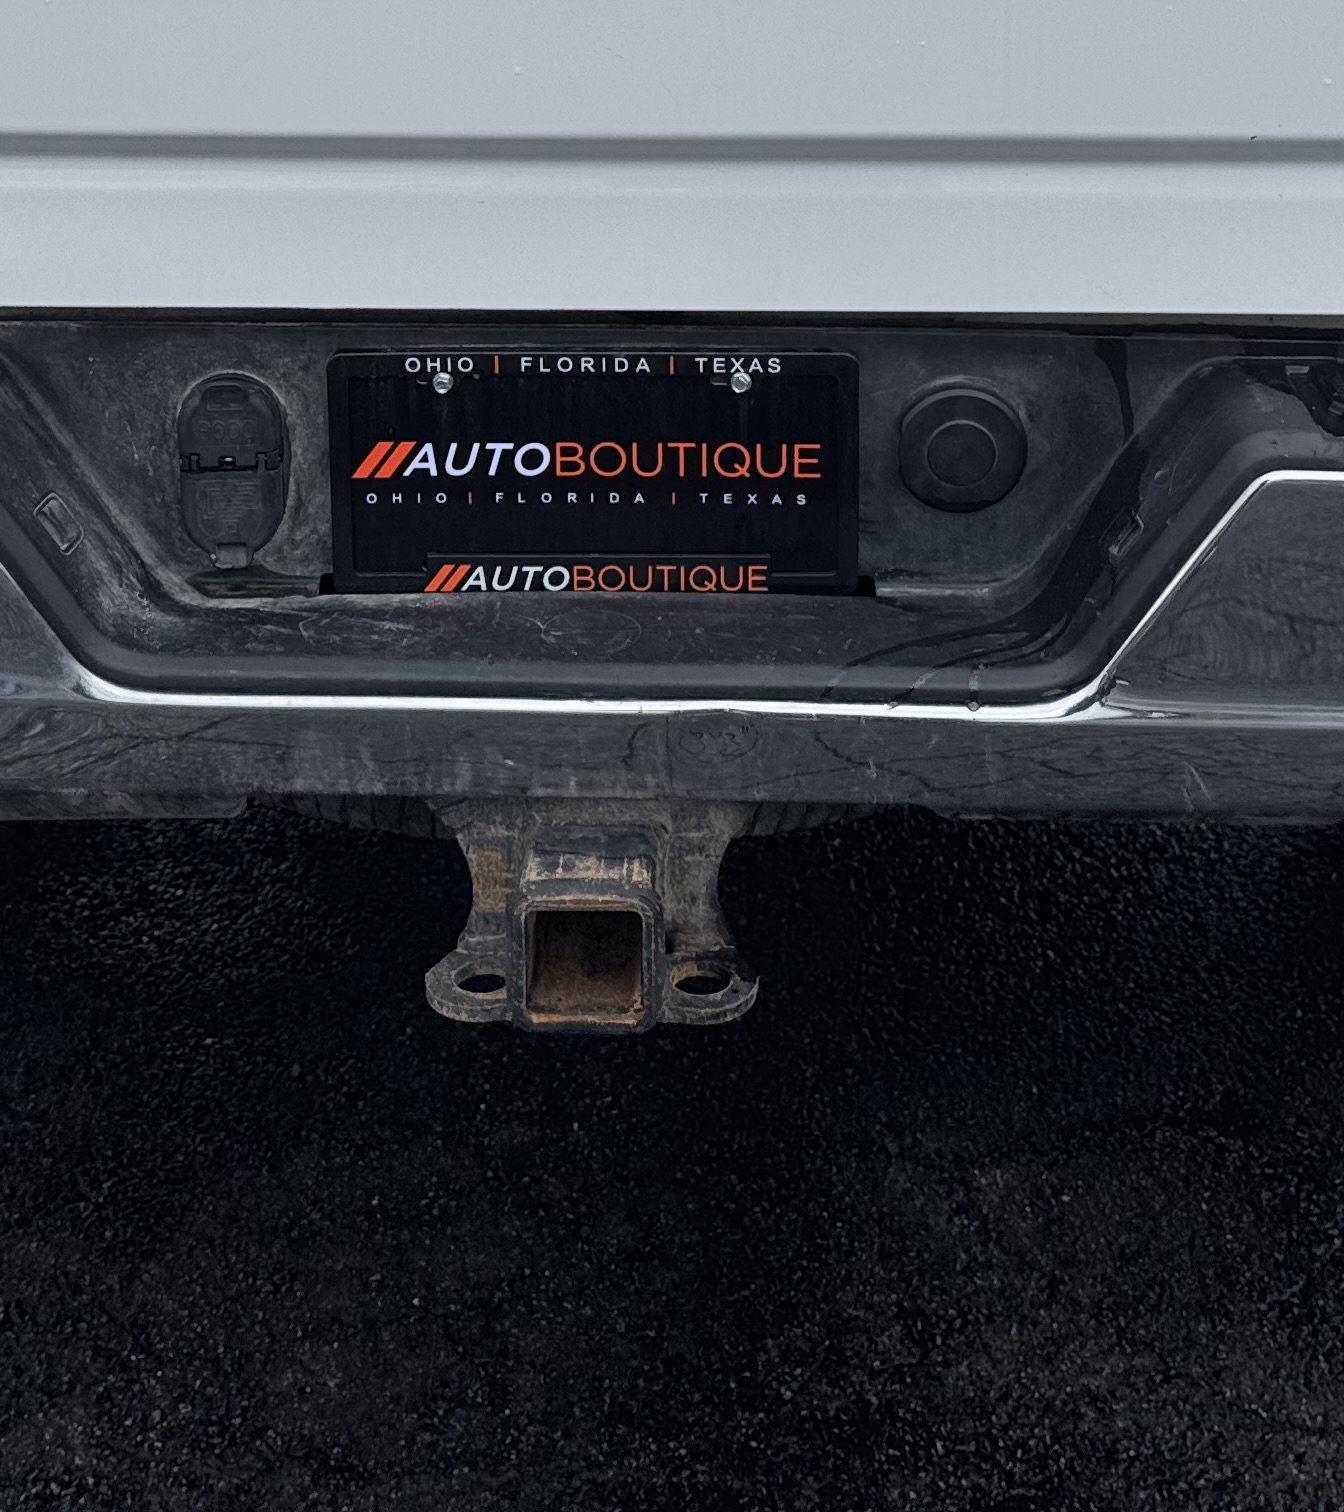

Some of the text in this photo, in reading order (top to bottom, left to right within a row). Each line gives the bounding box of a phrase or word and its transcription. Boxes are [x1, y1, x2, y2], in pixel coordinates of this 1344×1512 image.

[404, 356, 782, 375] OHIO FLORIDA TEXAS
[402, 442, 821, 479] AUTOBOUTIQUE
[365, 492, 807, 506] OHIO FLORIDA TEXAS
[461, 565, 769, 592] AUTOBOUTIQUE
